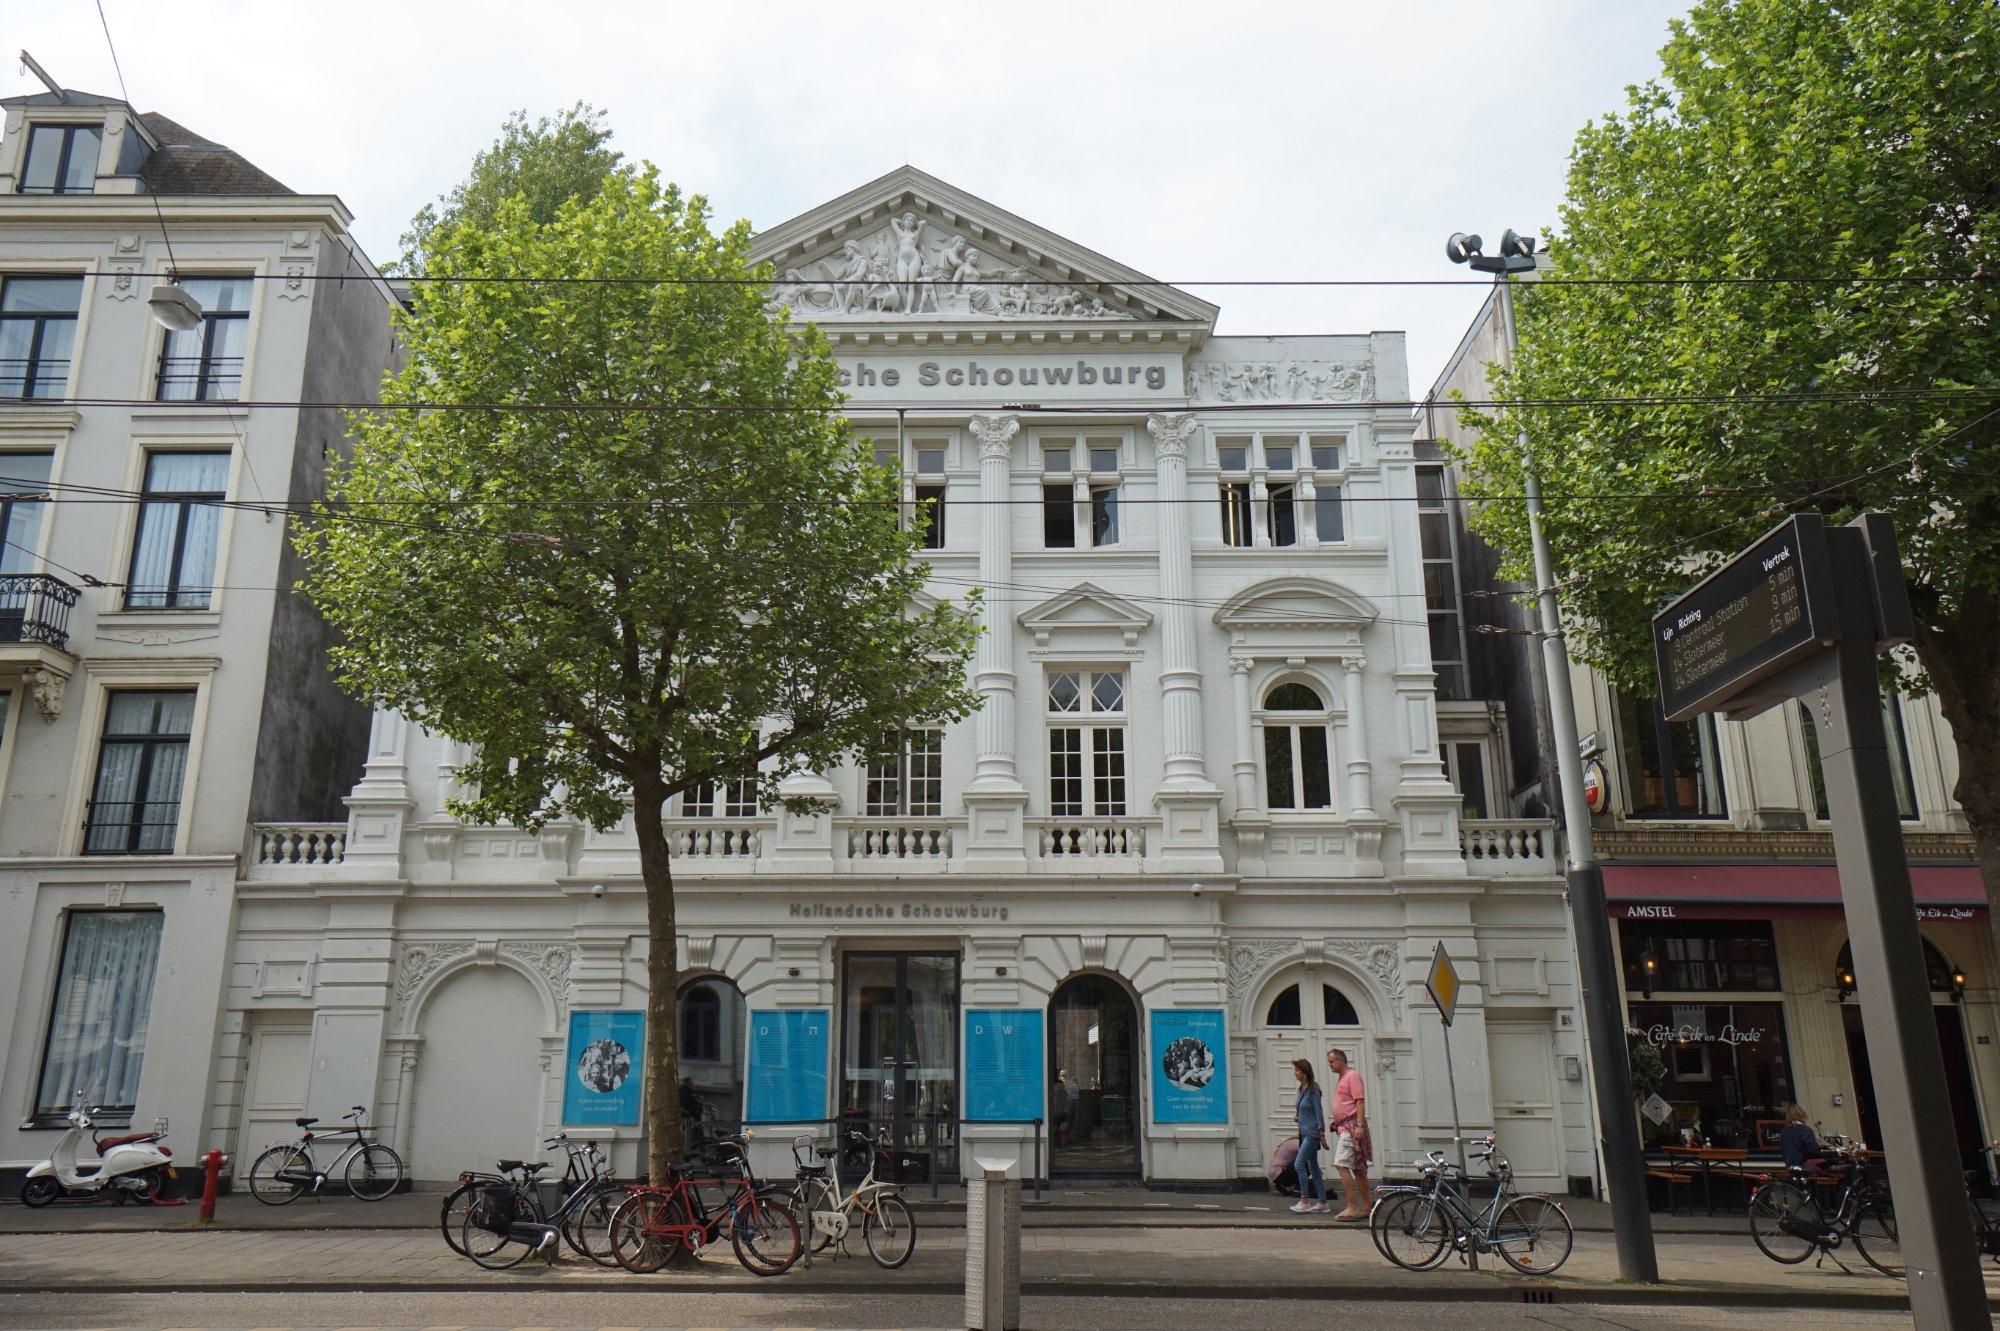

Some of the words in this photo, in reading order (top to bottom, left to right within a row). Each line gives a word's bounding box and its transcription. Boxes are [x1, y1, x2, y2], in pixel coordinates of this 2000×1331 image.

[918, 361, 1166, 390] Schouwburg
[1762, 545, 1791, 573] Vertrek
[1716, 596, 1750, 627] Station
[1768, 574, 1776, 591] 5
[1778, 566, 1795, 586] min
[1781, 585, 1798, 605] min
[1663, 627, 1674, 642] Lijn
[1678, 609, 1702, 631] Richting
[1769, 613, 1783, 634] 15
[1784, 606, 1801, 625] min
[789, 903, 895, 918] Hollandsche
[901, 903, 1009, 921] Schouwburg
[1627, 905, 1676, 918] AMSTEL
[1647, 1024, 1676, 1049] Café
